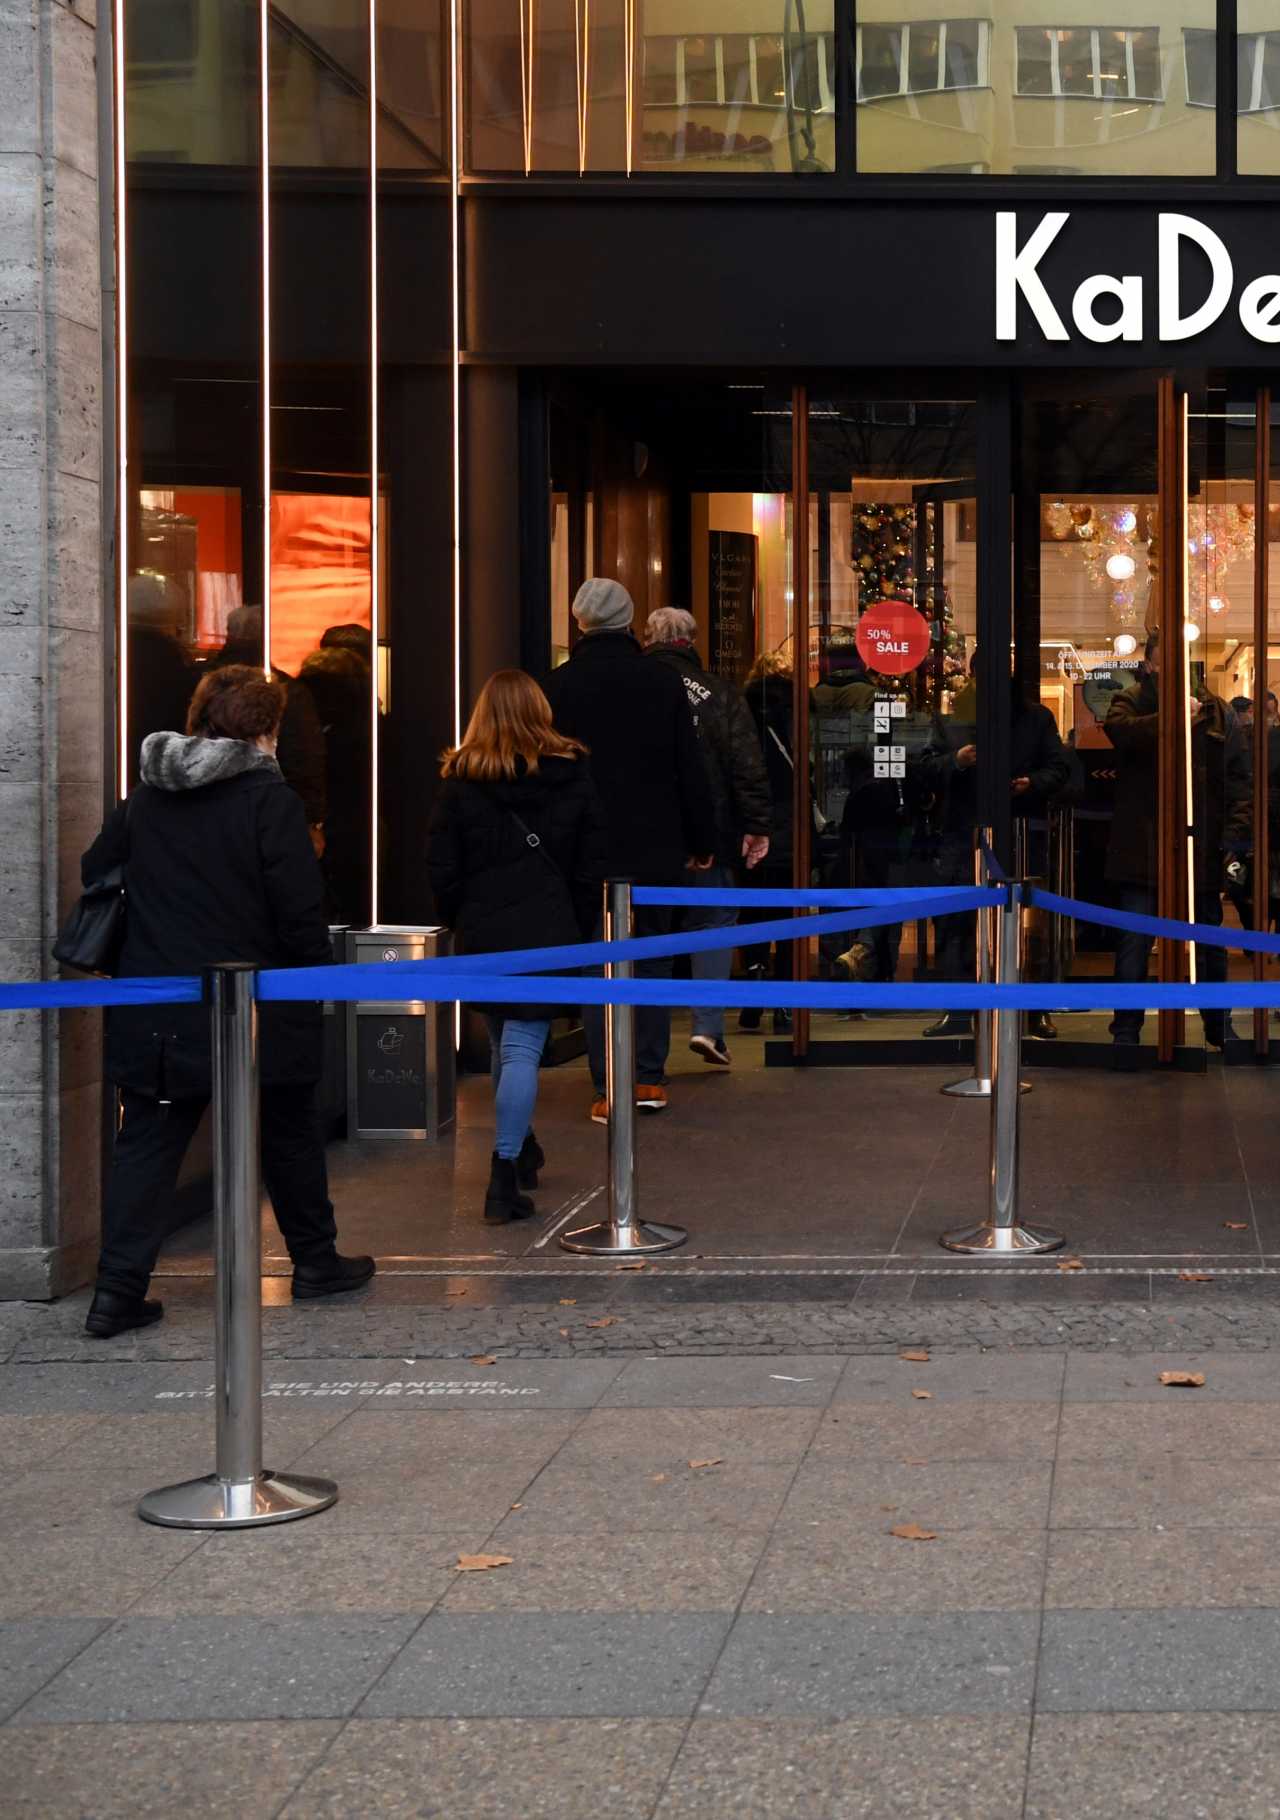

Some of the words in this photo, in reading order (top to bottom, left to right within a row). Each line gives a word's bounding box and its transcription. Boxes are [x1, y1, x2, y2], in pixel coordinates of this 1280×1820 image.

[867, 630, 891, 640] 50%
[876, 642, 909, 653] SALE
[1119, 660, 1139, 668] 2020
[1094, 671, 1112, 680] UHR
[681, 674, 712, 700] ORCE
[261, 1388, 353, 1397] ALTEN
[405, 1387, 541, 1395] ABSTAND
